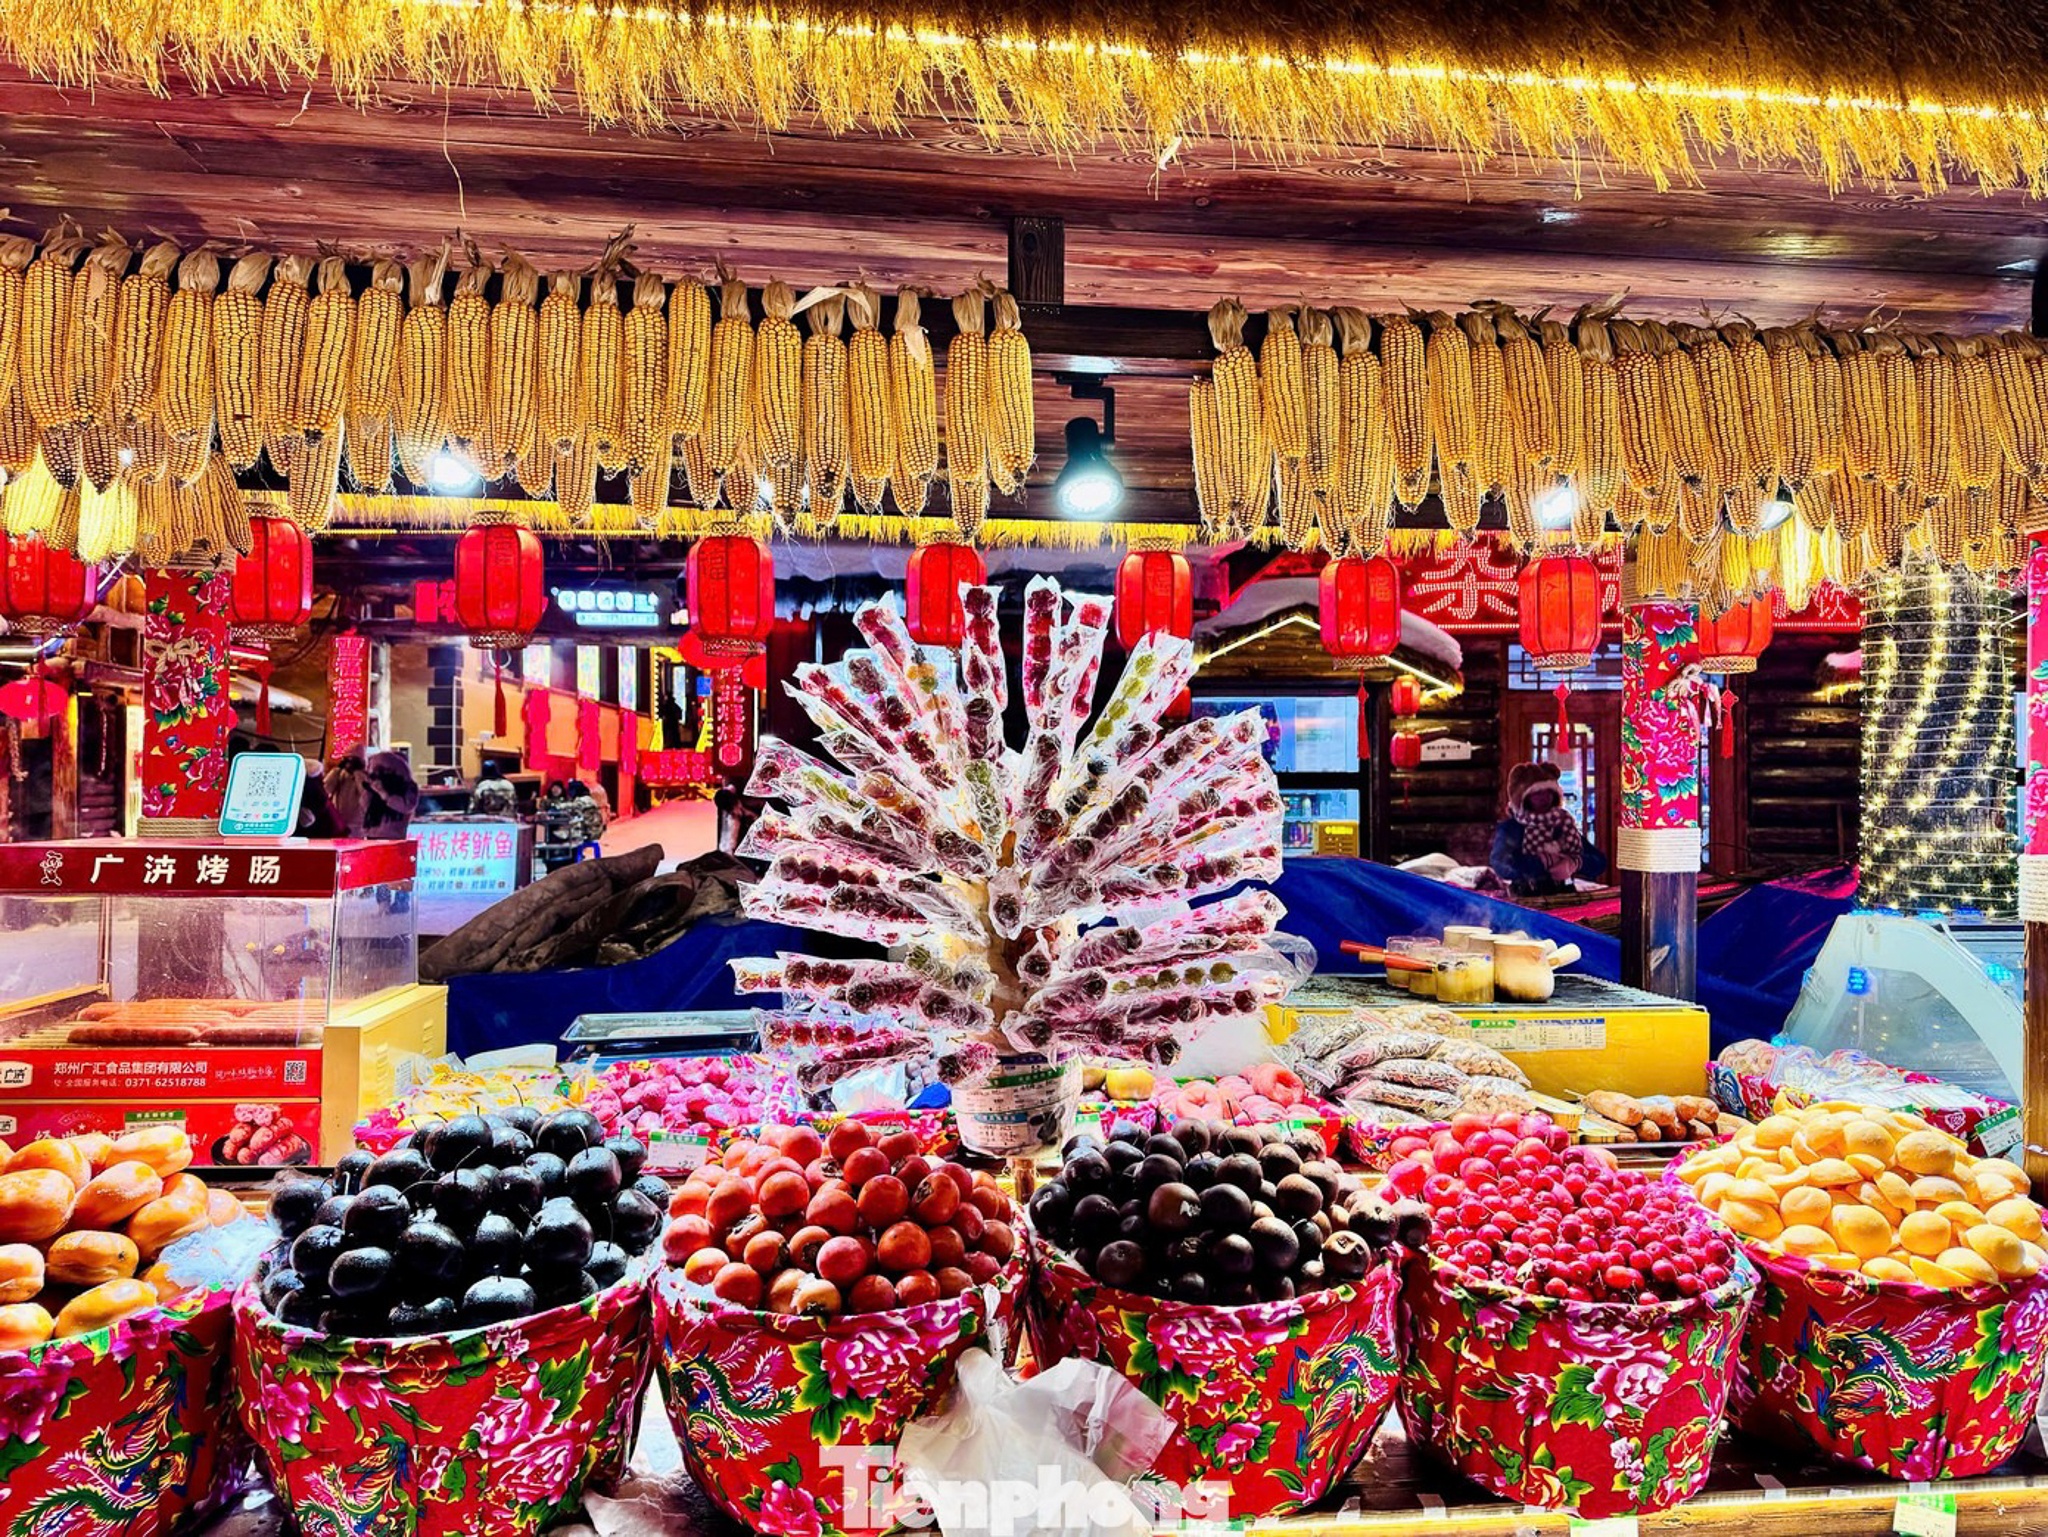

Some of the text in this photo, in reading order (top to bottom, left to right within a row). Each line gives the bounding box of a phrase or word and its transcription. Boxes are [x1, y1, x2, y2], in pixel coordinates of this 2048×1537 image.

[53, 1061, 208, 1075] 郑州广汇食品集团有限公司
